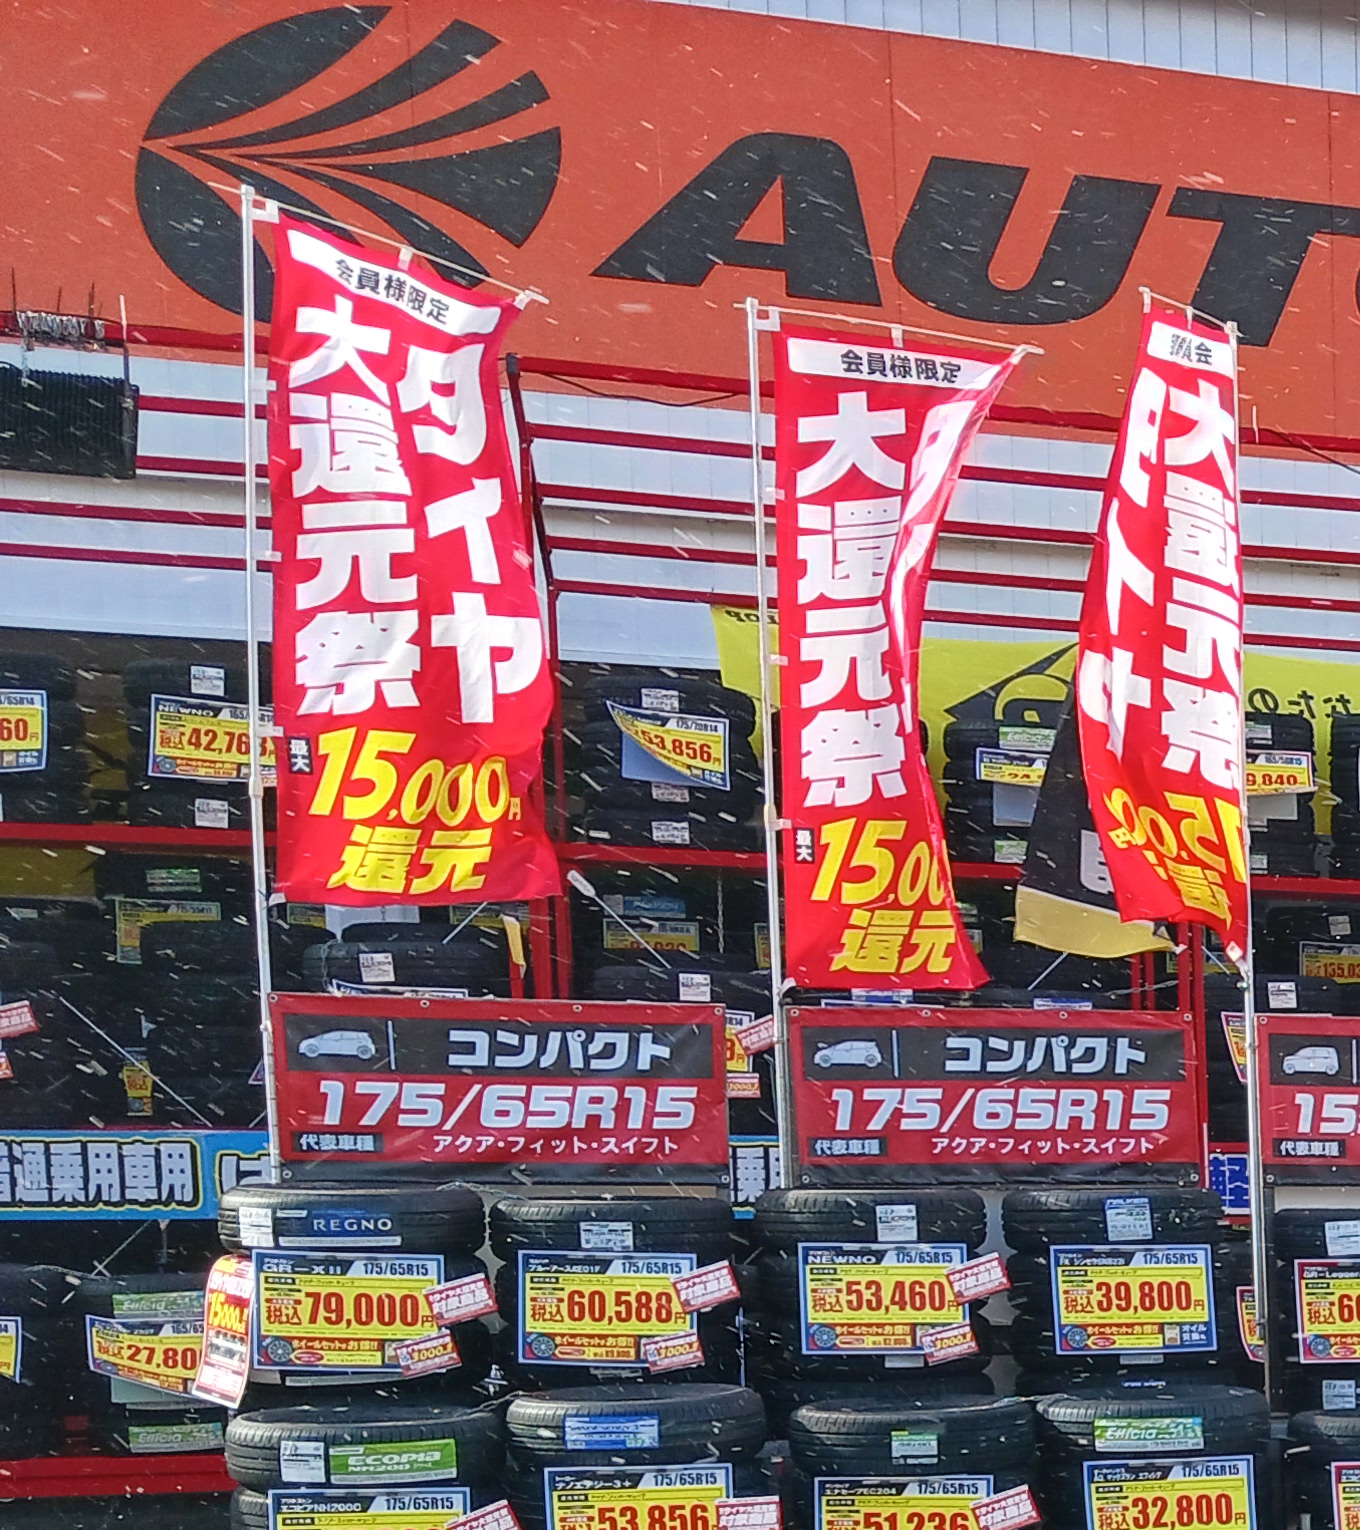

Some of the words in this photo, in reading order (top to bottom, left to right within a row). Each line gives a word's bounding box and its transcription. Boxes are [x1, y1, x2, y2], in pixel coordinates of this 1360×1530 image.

[335, 259, 450, 326] 会員様限定
[841, 348, 961, 384] 会員様限定
[289, 293, 422, 716] 大還元祭
[399, 343, 542, 722] タイヤ
[796, 391, 907, 807] 大還元祭
[326, 826, 493, 894] 還元
[832, 909, 955, 973] 還元
[446, 1028, 672, 1072] コンパクト
[944, 1034, 1147, 1076] コンパクト
[319, 1079, 697, 1130] 175/65R15
[830, 1086, 1170, 1132] 175/65R15
[433, 1134, 678, 1156] アクア・フィット・スイフト
[931, 1137, 1155, 1155] アクア・フィット・スイフト
[313, 1218, 393, 1231] REGNO
[363, 1262, 429, 1276] 175/65R15
[620, 1262, 682, 1274] 175/65R15
[807, 1254, 876, 1265] NEWNO
[894, 1251, 954, 1265] 175/65R15
[1142, 1252, 1200, 1265] 175/65R15
[304, 1291, 435, 1329] 79,000円
[566, 1289, 687, 1325] 60,588円
[1097, 1280, 1205, 1315] 39,800円
[653, 1473, 717, 1487] 175/65R15
[1181, 1464, 1240, 1478] 175/65R15
[385, 1498, 454, 1512] 175/65R15
[917, 1483, 979, 1496] 175/65R15
